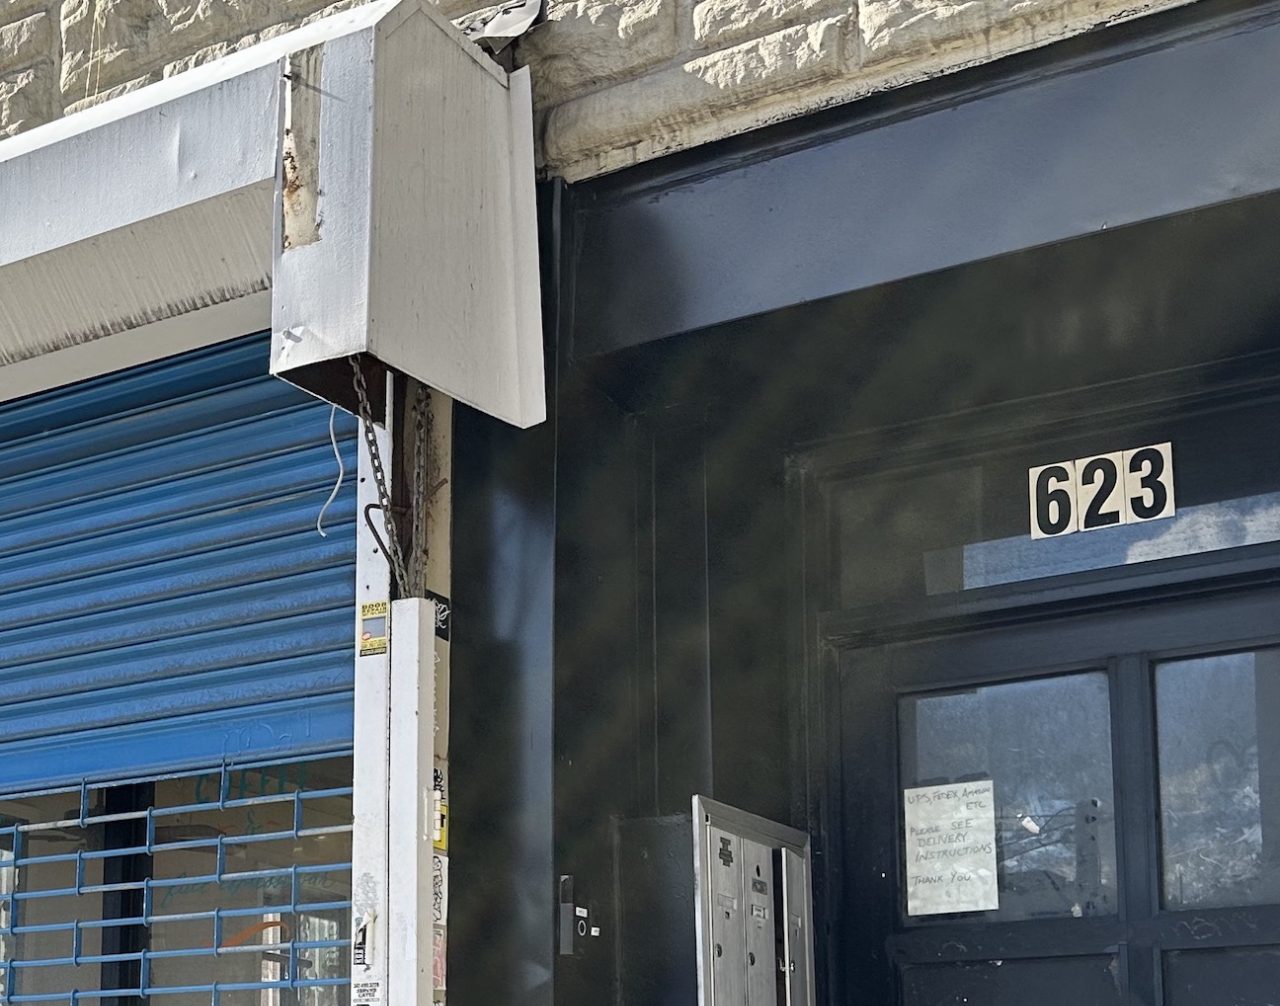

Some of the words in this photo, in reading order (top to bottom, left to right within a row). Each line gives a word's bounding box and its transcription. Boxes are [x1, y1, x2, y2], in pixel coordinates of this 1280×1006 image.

[1035, 447, 1168, 536] 623
[951, 818, 974, 831] SEE
[917, 831, 969, 848] DELIVERY
[915, 842, 993, 863] INSTRUCTIONS
[911, 875, 944, 887] THANK
[950, 870, 971, 884] YOU
